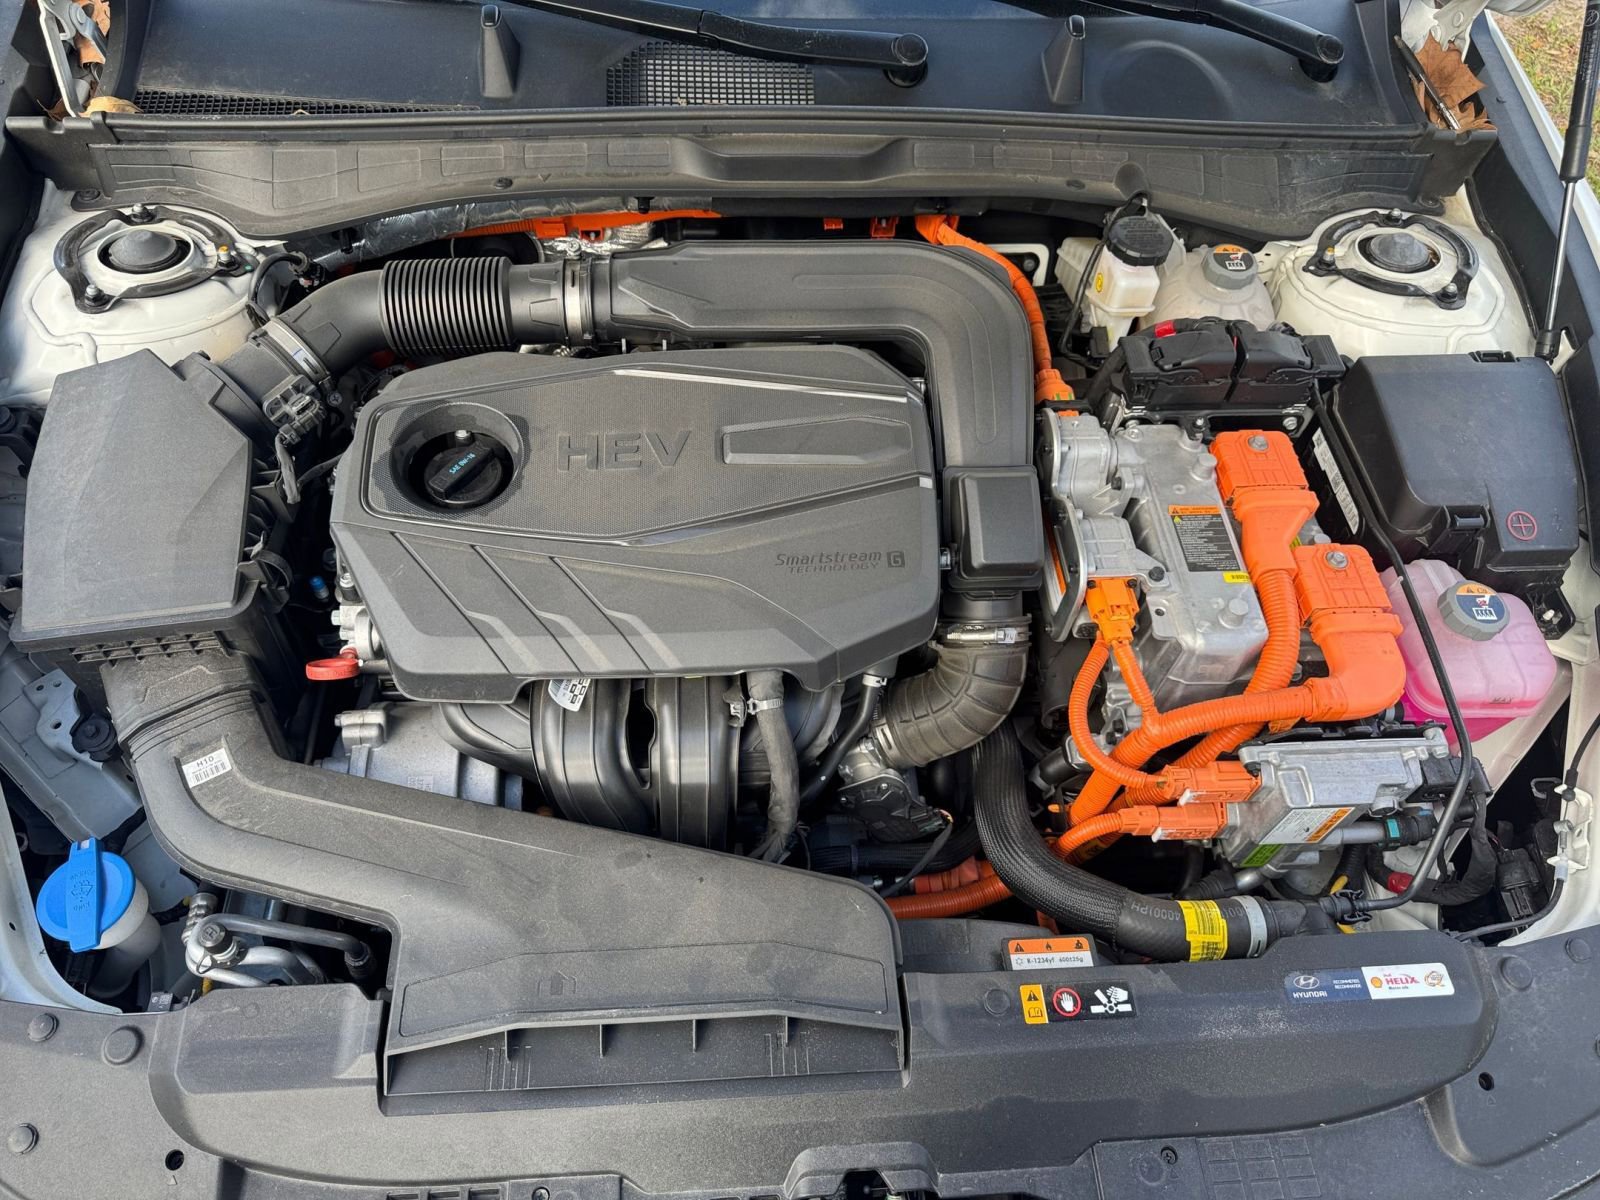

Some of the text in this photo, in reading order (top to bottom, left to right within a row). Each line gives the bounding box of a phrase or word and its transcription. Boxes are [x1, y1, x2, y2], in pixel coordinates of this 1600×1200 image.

[557, 430, 692, 471] HEV
[775, 551, 882, 566] Smartstream
[788, 561, 879, 574] TECHNOLOGY
[1027, 956, 1055, 965] R-1234yf
[1385, 976, 1418, 985] HELIX
[1292, 990, 1328, 999] HYUNDAI
